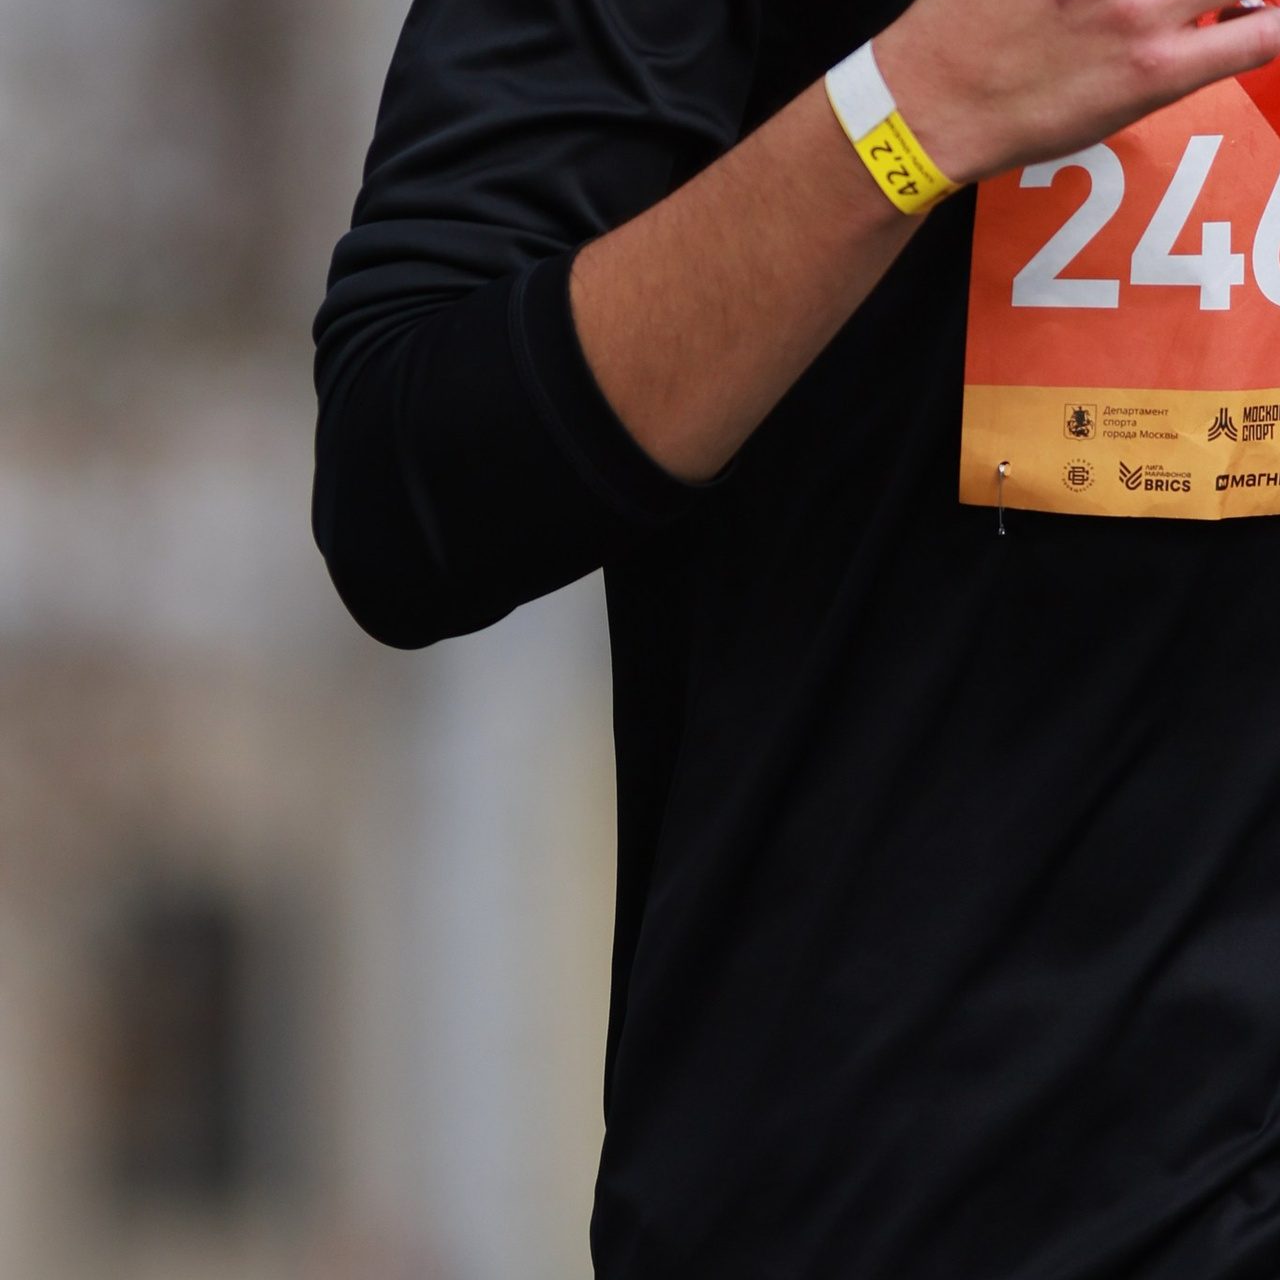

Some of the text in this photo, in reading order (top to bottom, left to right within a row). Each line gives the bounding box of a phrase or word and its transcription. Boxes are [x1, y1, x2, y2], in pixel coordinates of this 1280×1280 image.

[870, 138, 920, 197] 42,2
[1103, 405, 1169, 417] Департамент
[1103, 417, 1137, 428] спорта
[1103, 430, 1179, 441] города Москвы
[1242, 423, 1275, 441] СПОРТ
[1144, 479, 1191, 492] BRICS
